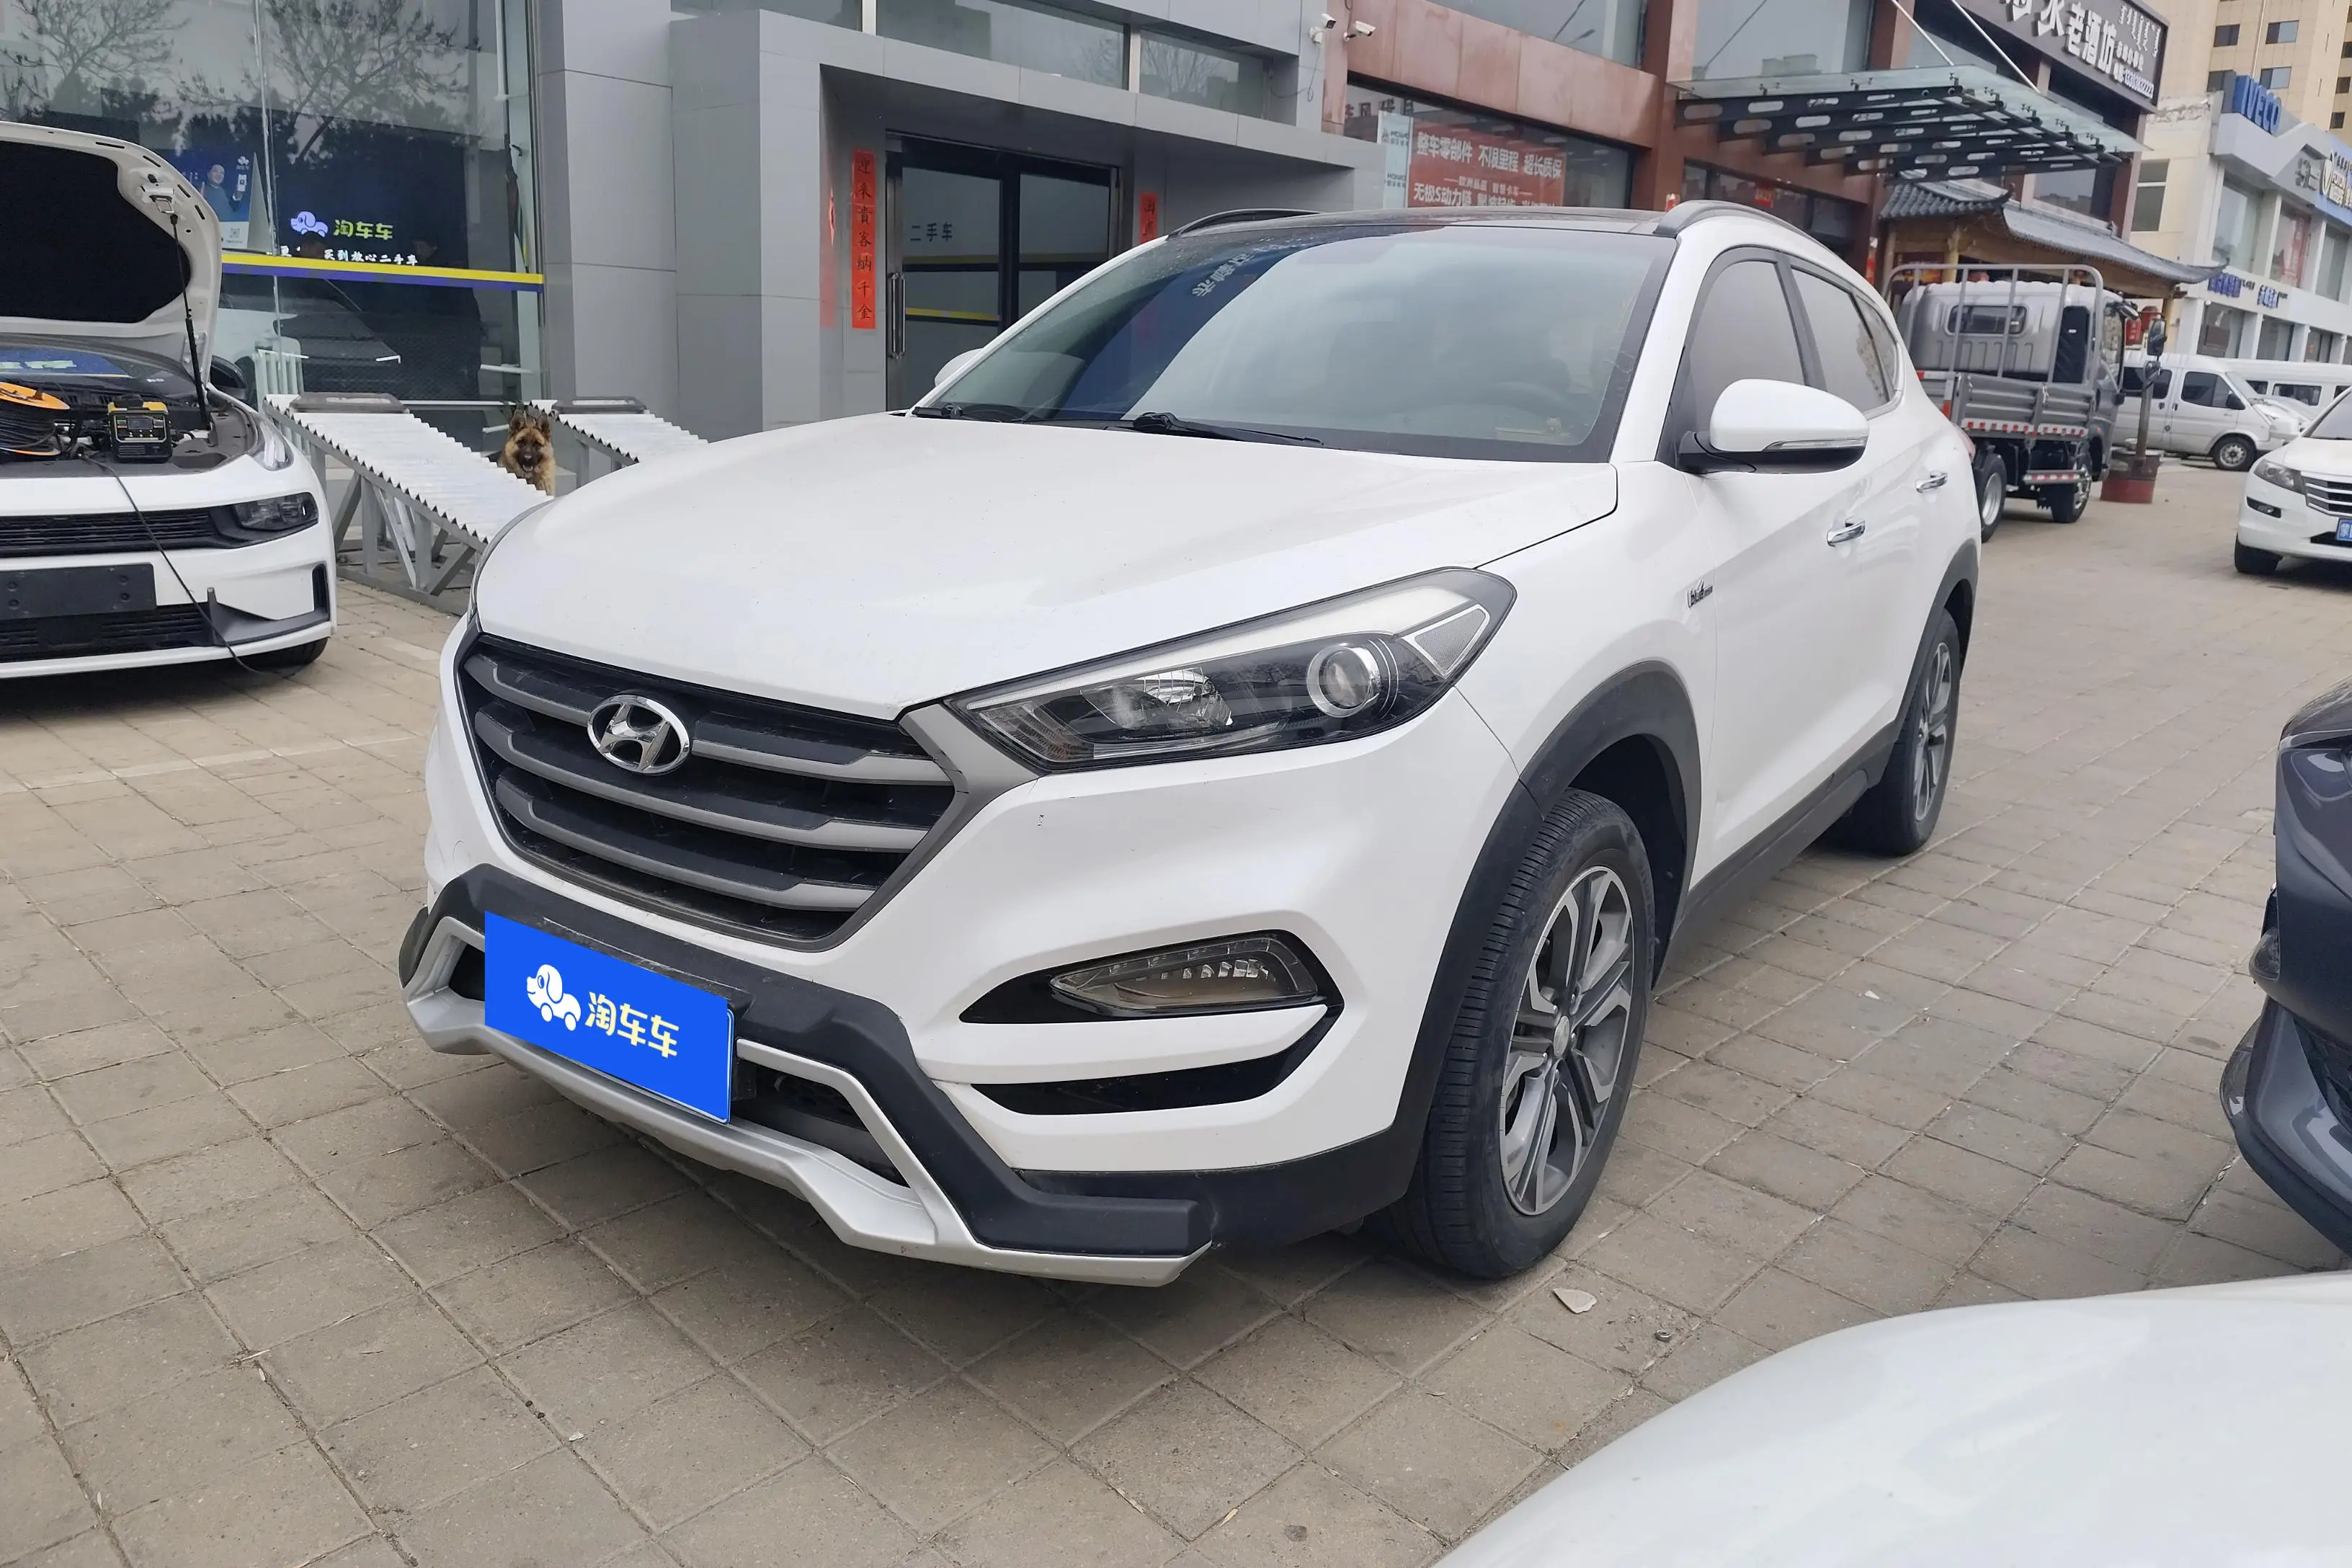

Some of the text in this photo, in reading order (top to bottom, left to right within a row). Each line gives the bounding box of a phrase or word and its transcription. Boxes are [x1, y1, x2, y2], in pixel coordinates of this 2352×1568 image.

[2240, 75, 2281, 135] IVECO
[1417, 131, 1562, 179] 整车零部件 不限里程 超长质保
[333, 219, 393, 241] 淘车车
[910, 222, 953, 242] 二手车
